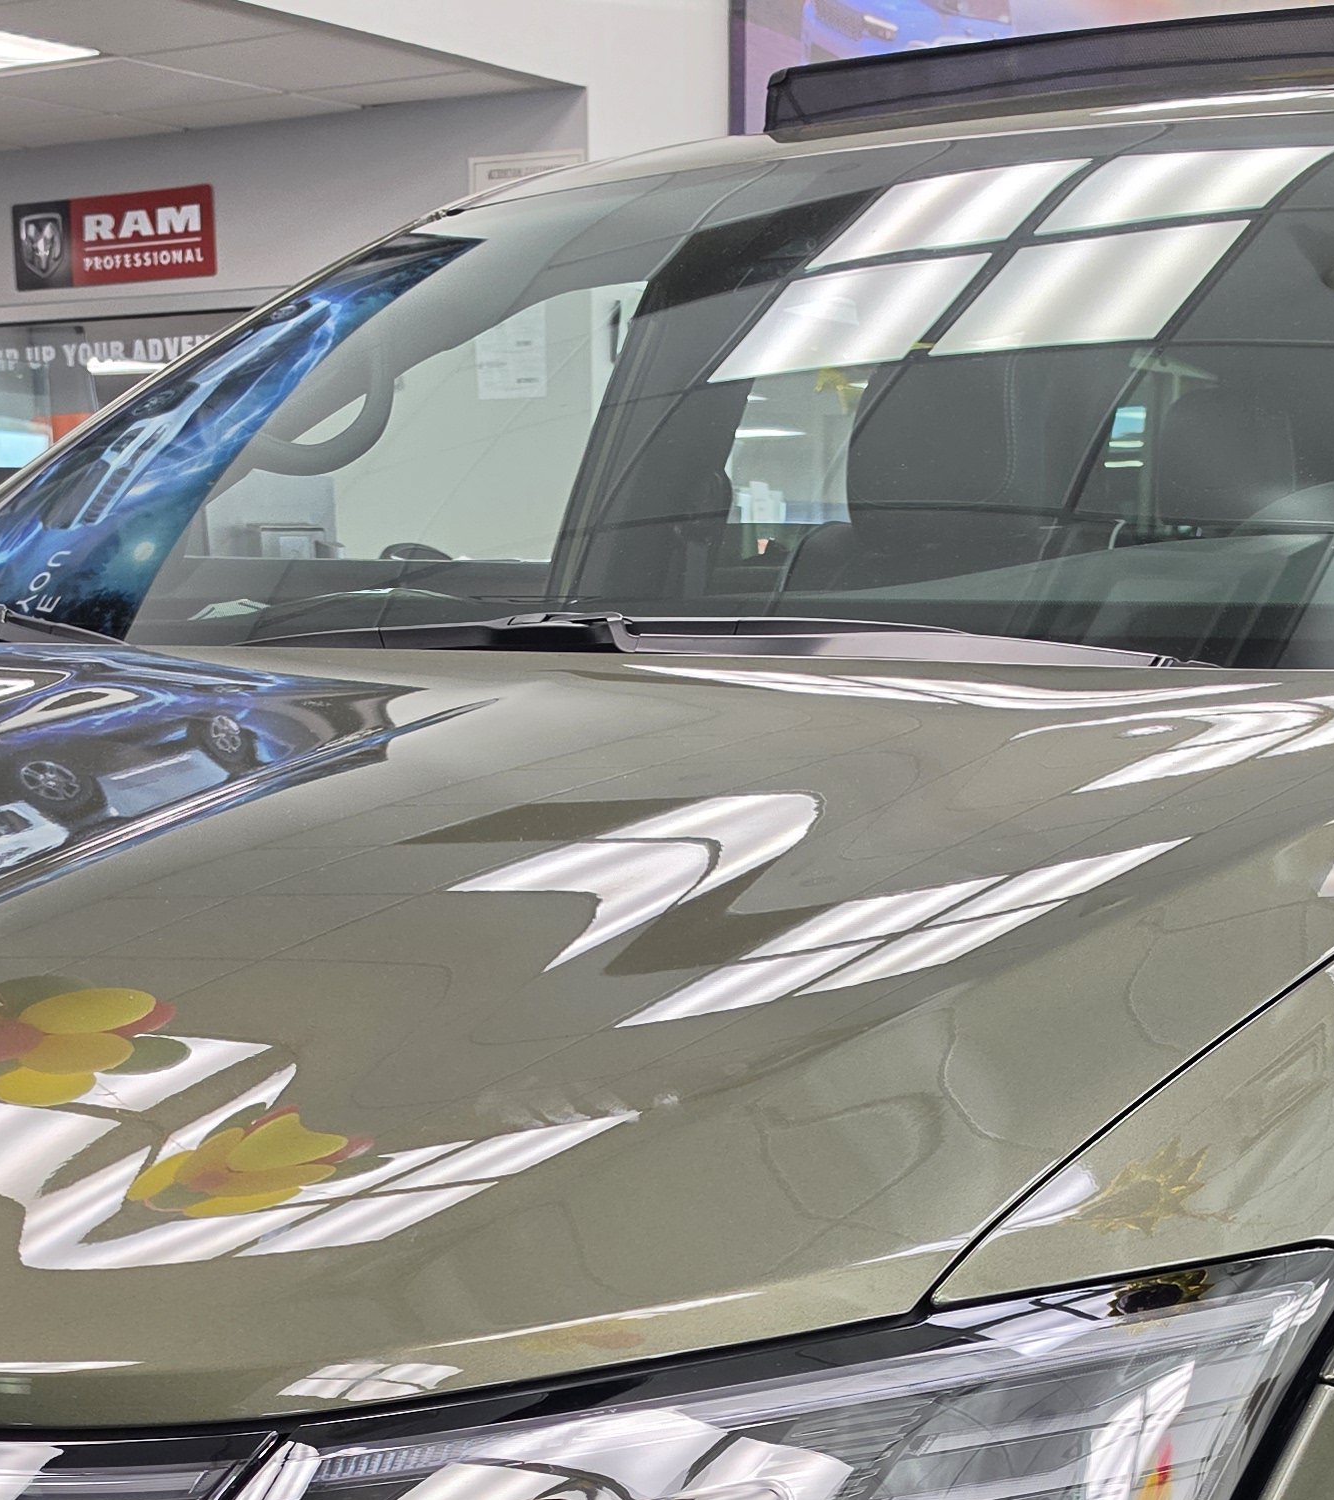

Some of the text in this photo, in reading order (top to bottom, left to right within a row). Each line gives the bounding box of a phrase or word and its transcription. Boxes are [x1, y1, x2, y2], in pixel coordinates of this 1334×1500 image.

[82, 204, 202, 242] RAM
[82, 247, 204, 272] PROFESSIONAL
[25, 345, 57, 369] UP
[63, 340, 126, 367] YOUR
